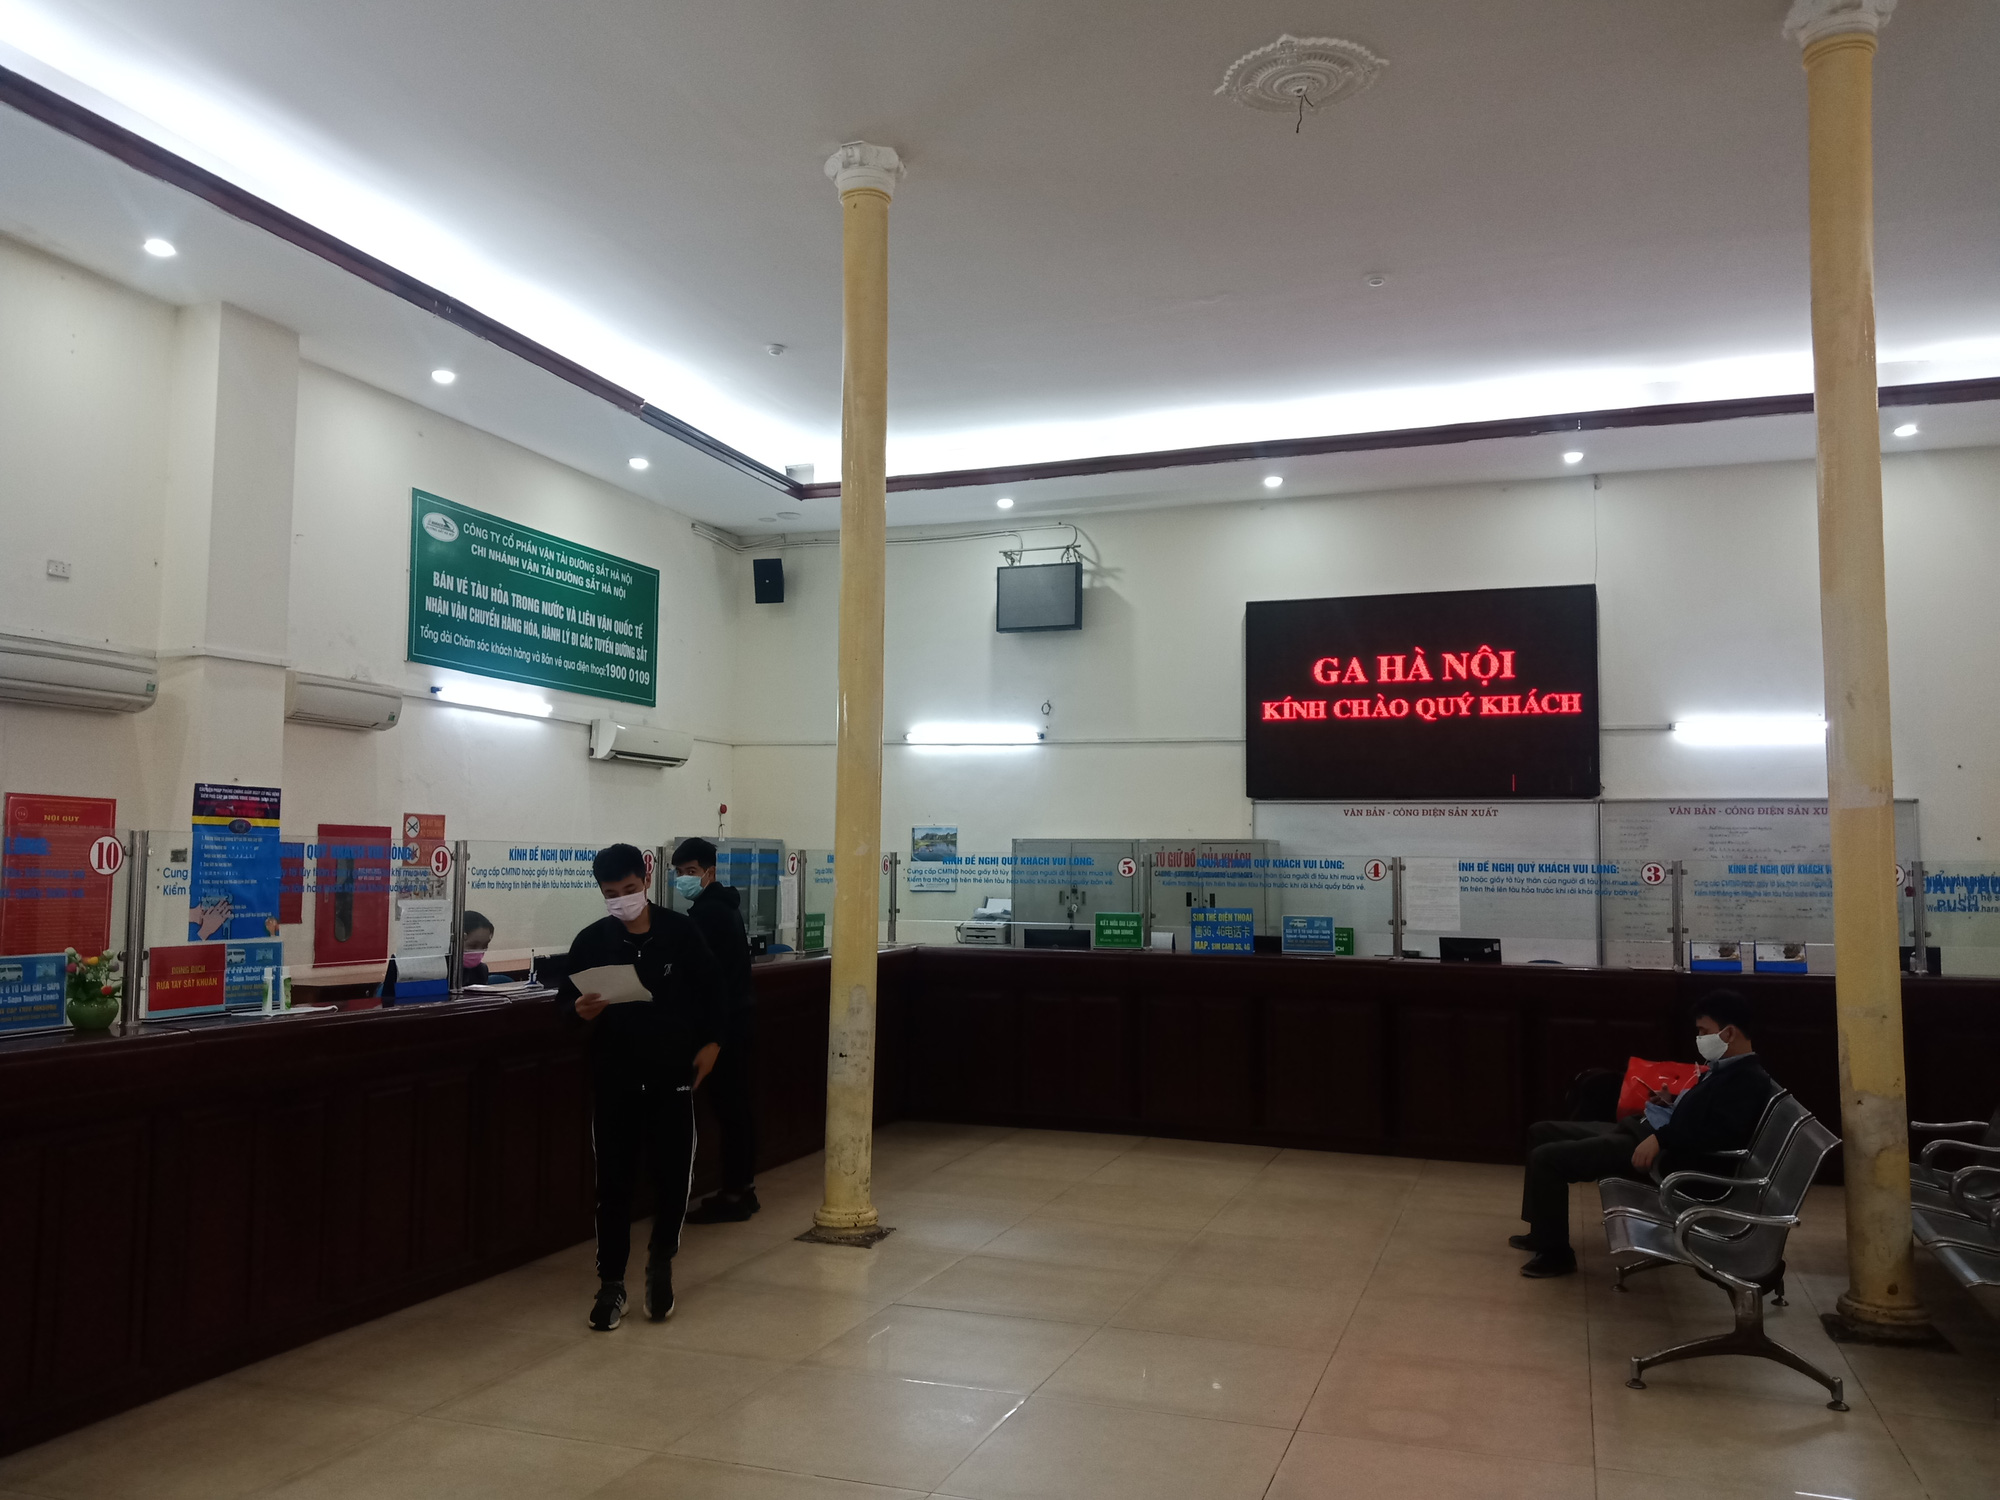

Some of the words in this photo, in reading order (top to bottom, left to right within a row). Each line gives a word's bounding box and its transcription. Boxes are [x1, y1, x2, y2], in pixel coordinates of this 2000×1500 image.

[463, 523, 488, 540] CÔNG
[490, 531, 500, 543] TY
[611, 569, 620, 580] HÀ
[622, 573, 632, 586] NỘI
[471, 544, 486, 557] CHI
[489, 549, 519, 567] NHÁNH
[522, 559, 539, 574] VẬN
[602, 583, 611, 594] HÀ
[614, 586, 625, 600] NỘI
[433, 571, 454, 591] BÁN
[457, 577, 468, 595] VÉ
[471, 580, 488, 600] TÀU
[491, 583, 509, 606] HỎA
[511, 593, 539, 613] TRONG
[566, 606, 576, 623] VÀ
[579, 610, 595, 627] LIÊN
[597, 614, 612, 632] VẬN
[614, 619, 632, 637] QUỐC
[635, 623, 643, 639] TẾ
[426, 596, 449, 617] NHẬN
[451, 601, 467, 622] VẬN
[469, 607, 499, 628] CHUYỂN
[501, 614, 521, 635] HÀNG
[542, 624, 560, 641] HÀNH
[562, 628, 569, 644] LÝ
[572, 632, 578, 646] ĐI
[580, 633, 592, 649] CÁC
[594, 636, 613, 654] TUYẾN
[420, 624, 438, 643] Tổng
[440, 630, 452, 643] đài
[454, 634, 475, 649] Chăm
[477, 639, 489, 651] sóc
[491, 642, 512, 656] khách
[514, 647, 530, 663] hàng
[532, 651, 540, 662] và
[542, 653, 553, 665] Bán
[555, 656, 561, 667] vé
[564, 660, 575, 670] qua
[577, 661, 589, 674] điện
[606, 664, 626, 680] 1900
[629, 669, 649, 685] 0109
[1313, 657, 1367, 684] GA
[1377, 647, 1433, 682] HÀ
[1442, 644, 1516, 685] NỘI
[1262, 696, 1326, 720] KÍNH
[1333, 693, 1409, 718] CHÀO
[1416, 692, 1474, 720] QUÝ
[1480, 689, 1582, 716] KHÁCH
[1393, 807, 1419, 816] CÔNG
[1422, 809, 1445, 818] ĐIỆN
[1471, 807, 1498, 816] XUẤT
[97, 842, 119, 869] 10
[435, 851, 448, 872] 9
[509, 846, 527, 860] KÍNH
[541, 849, 557, 863] NGHỊ
[575, 848, 596, 861] KHÁCH
[978, 857, 999, 867] NGHỊ
[1053, 857, 1066, 865] VUI
[644, 855, 652, 873] 8
[791, 857, 796, 871] 7
[883, 859, 888, 871] 6
[1121, 860, 1133, 875] 5
[1273, 857, 1300, 868] KHÁCH
[1303, 860, 1317, 868] VUI
[1367, 862, 1379, 877] 4
[1492, 863, 1514, 874] NGHỊ
[1539, 861, 1570, 873] KHÁCH
[1573, 864, 1588, 873] VUI
[163, 868, 188, 880] Cung
[471, 867, 487, 877] Cung
[1647, 866, 1660, 881] 3
[163, 882, 186, 895] Kiểm
[1937, 899, 1978, 912] PUSH
